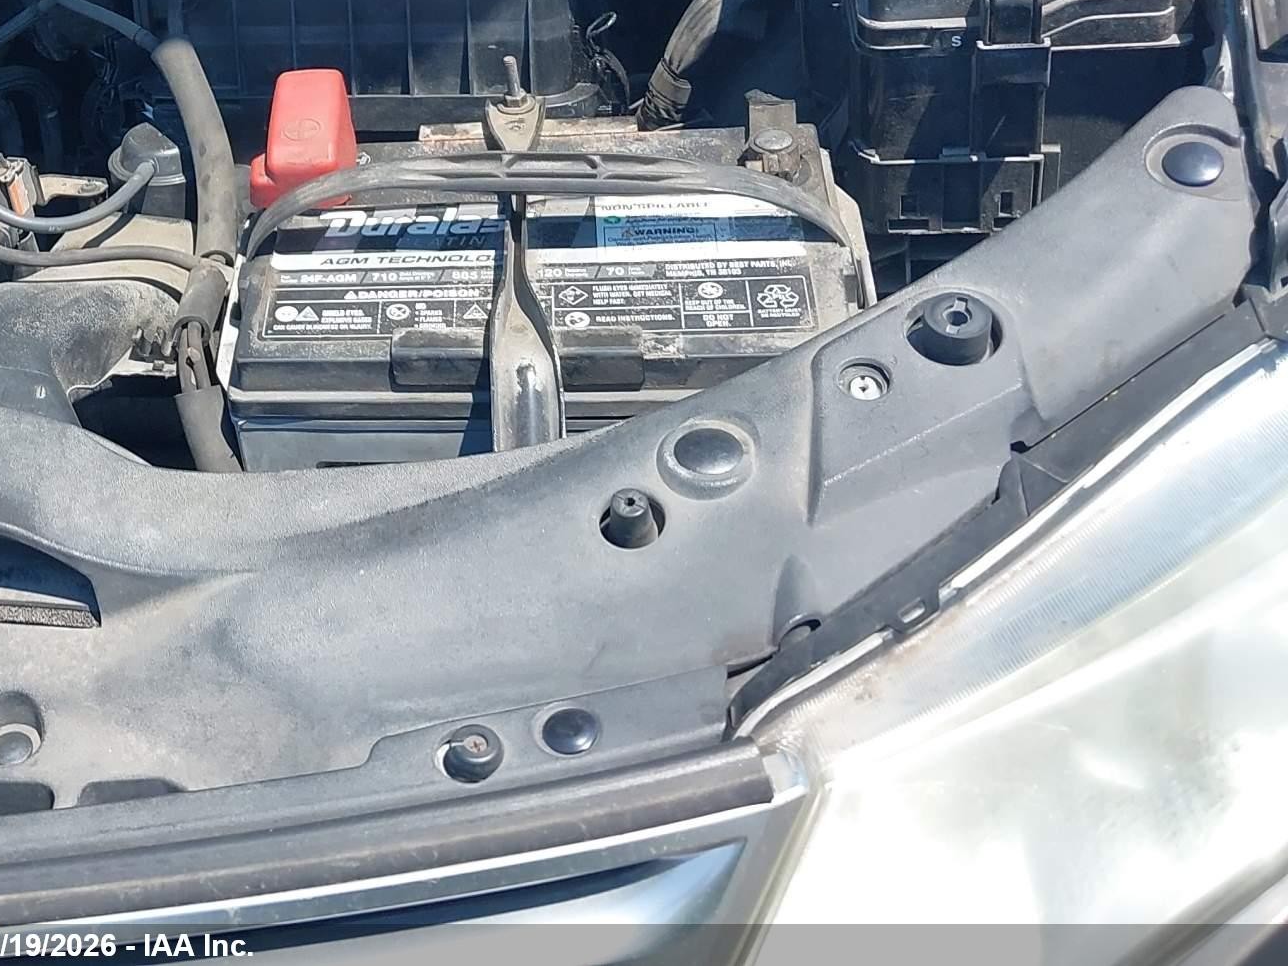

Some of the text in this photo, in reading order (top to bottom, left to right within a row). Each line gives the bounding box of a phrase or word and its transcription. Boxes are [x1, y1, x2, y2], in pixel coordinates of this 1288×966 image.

[320, 207, 506, 237] Duralas
[321, 254, 496, 266] AGM TECHNOLO
[606, 266, 624, 276] 70
[665, 262, 715, 271] DISTRIBUTED
[372, 272, 398, 282] 710
[358, 288, 479, 299] DANGER/POISON
[595, 315, 616, 323] READ
